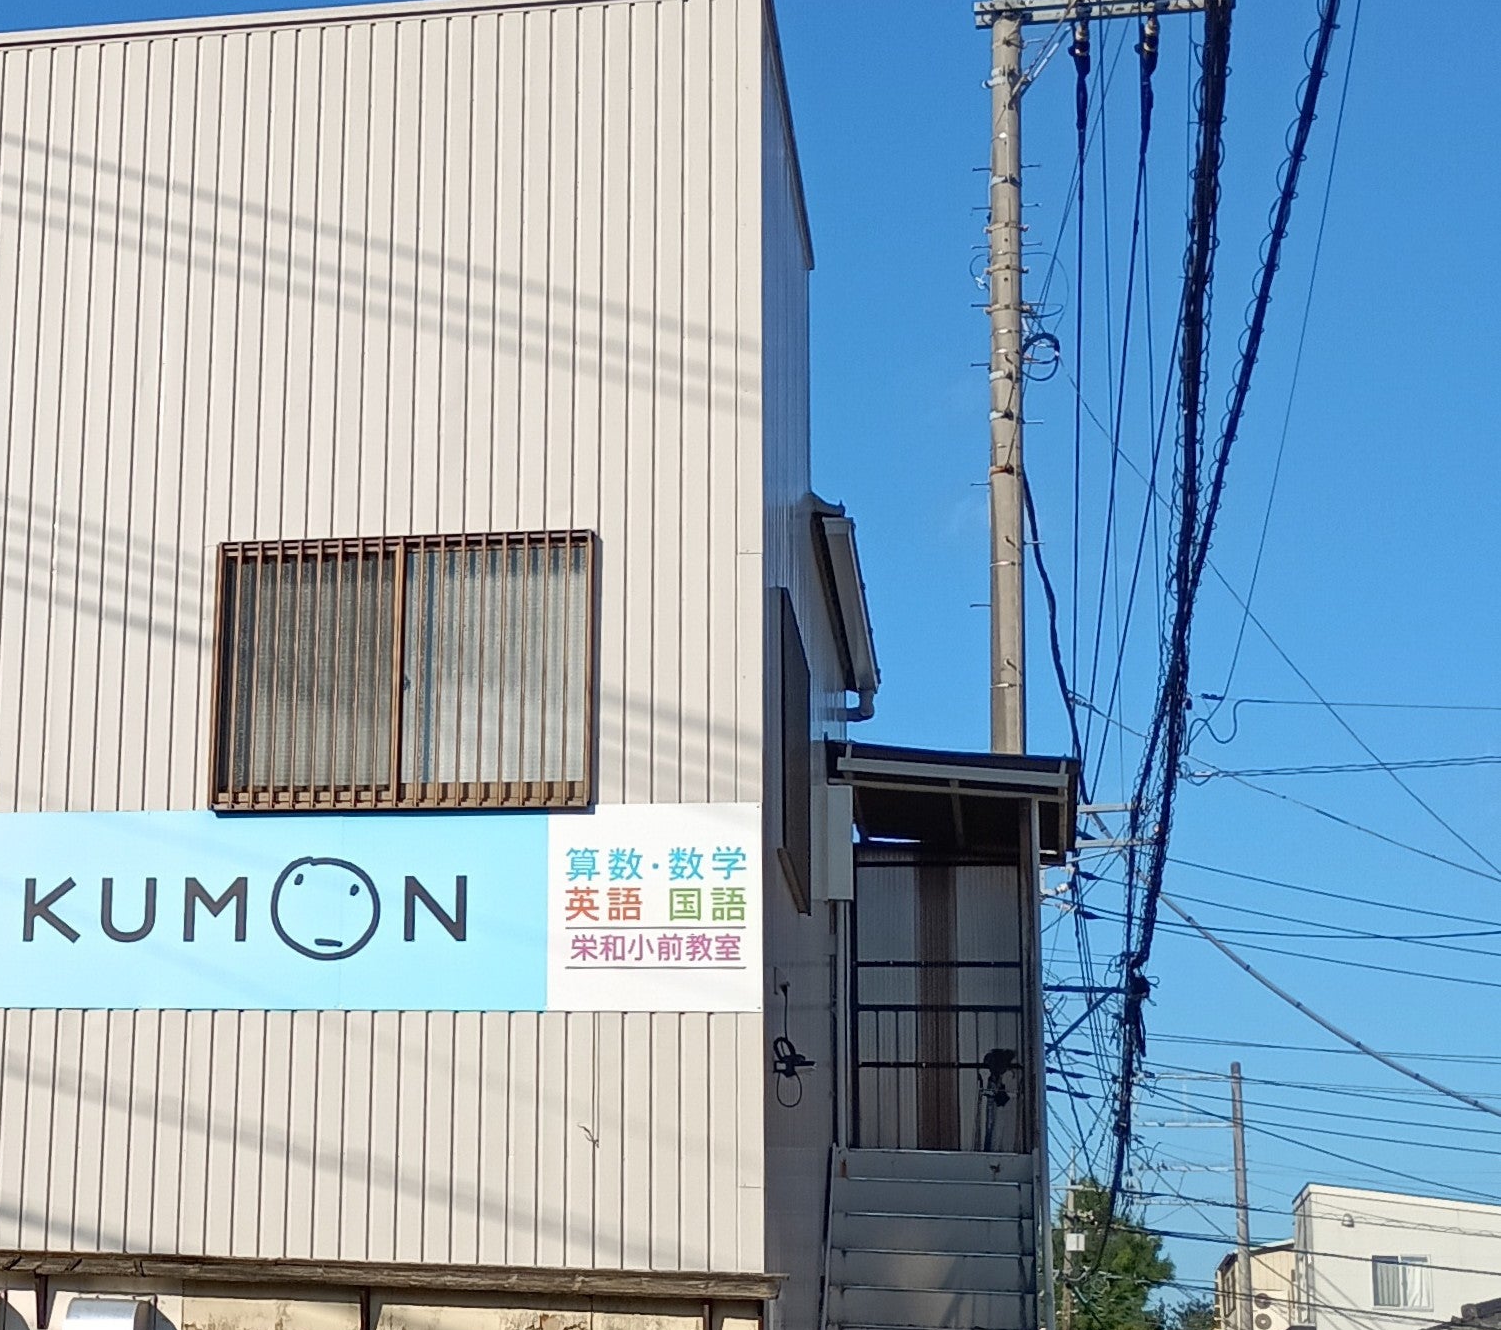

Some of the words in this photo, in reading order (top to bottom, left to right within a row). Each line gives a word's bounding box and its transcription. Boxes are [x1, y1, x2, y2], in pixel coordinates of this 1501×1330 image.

[22, 857, 467, 961] KUMON
[565, 886, 643, 921] 英語
[669, 887, 747, 921] 国語
[570, 933, 741, 962] 栄和小前教室
